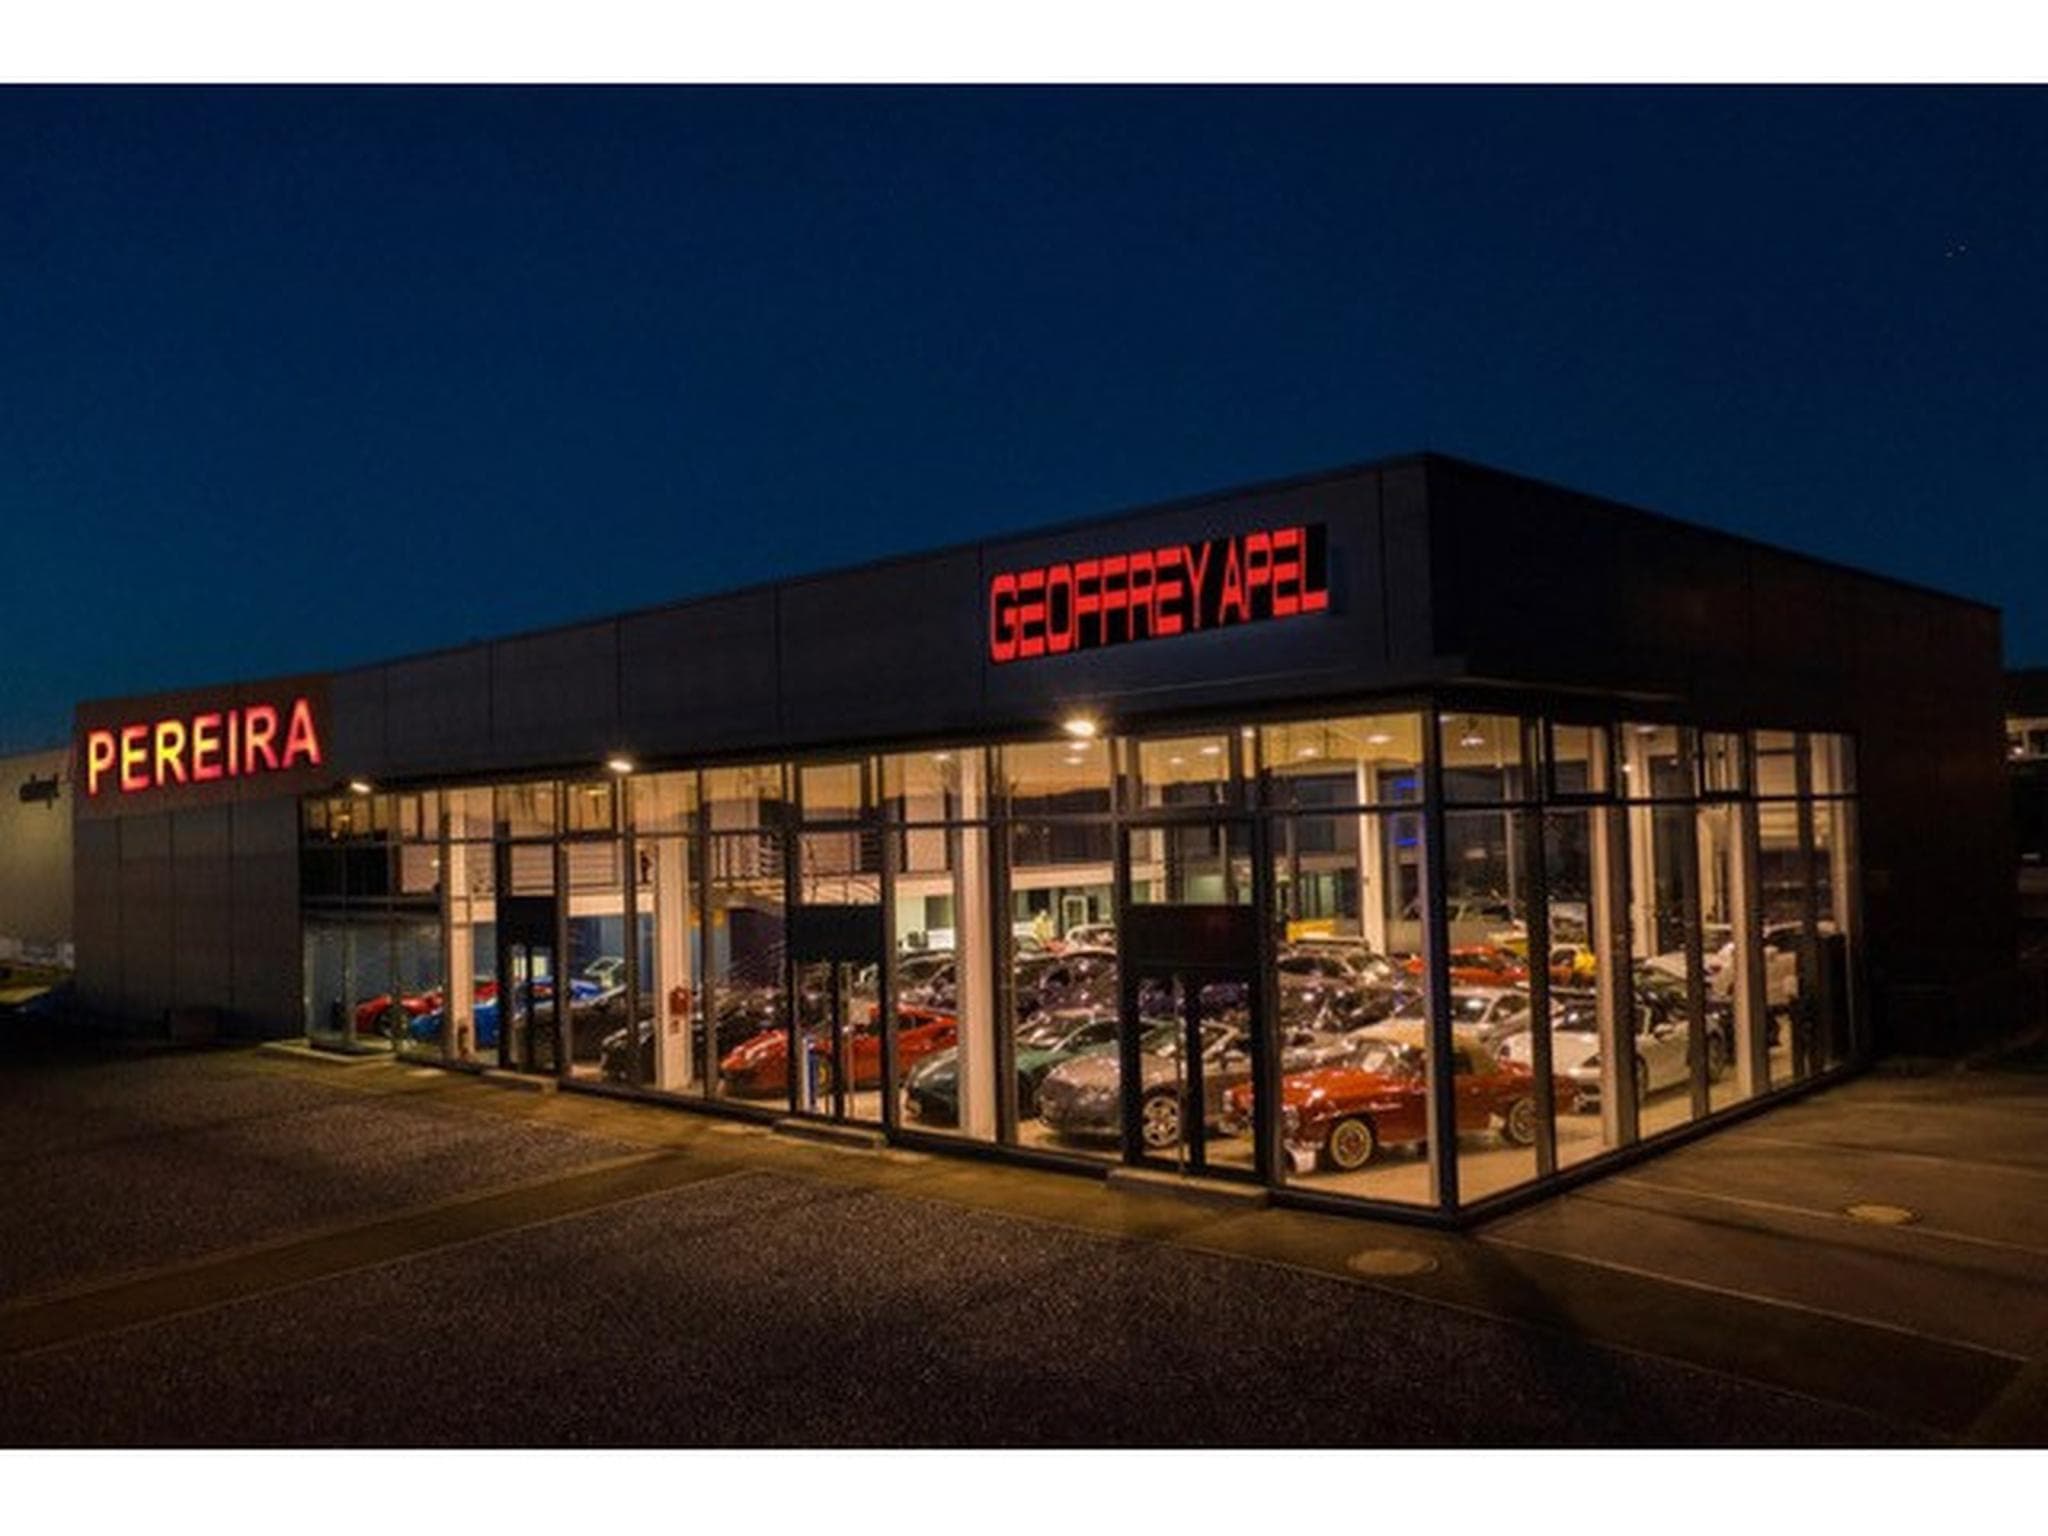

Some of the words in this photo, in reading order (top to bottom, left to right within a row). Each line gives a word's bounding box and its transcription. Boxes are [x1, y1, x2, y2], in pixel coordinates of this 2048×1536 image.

[990, 541, 1210, 662] GEOFFREY
[1219, 527, 1328, 627] APEL
[88, 697, 321, 796] PEREIRA
